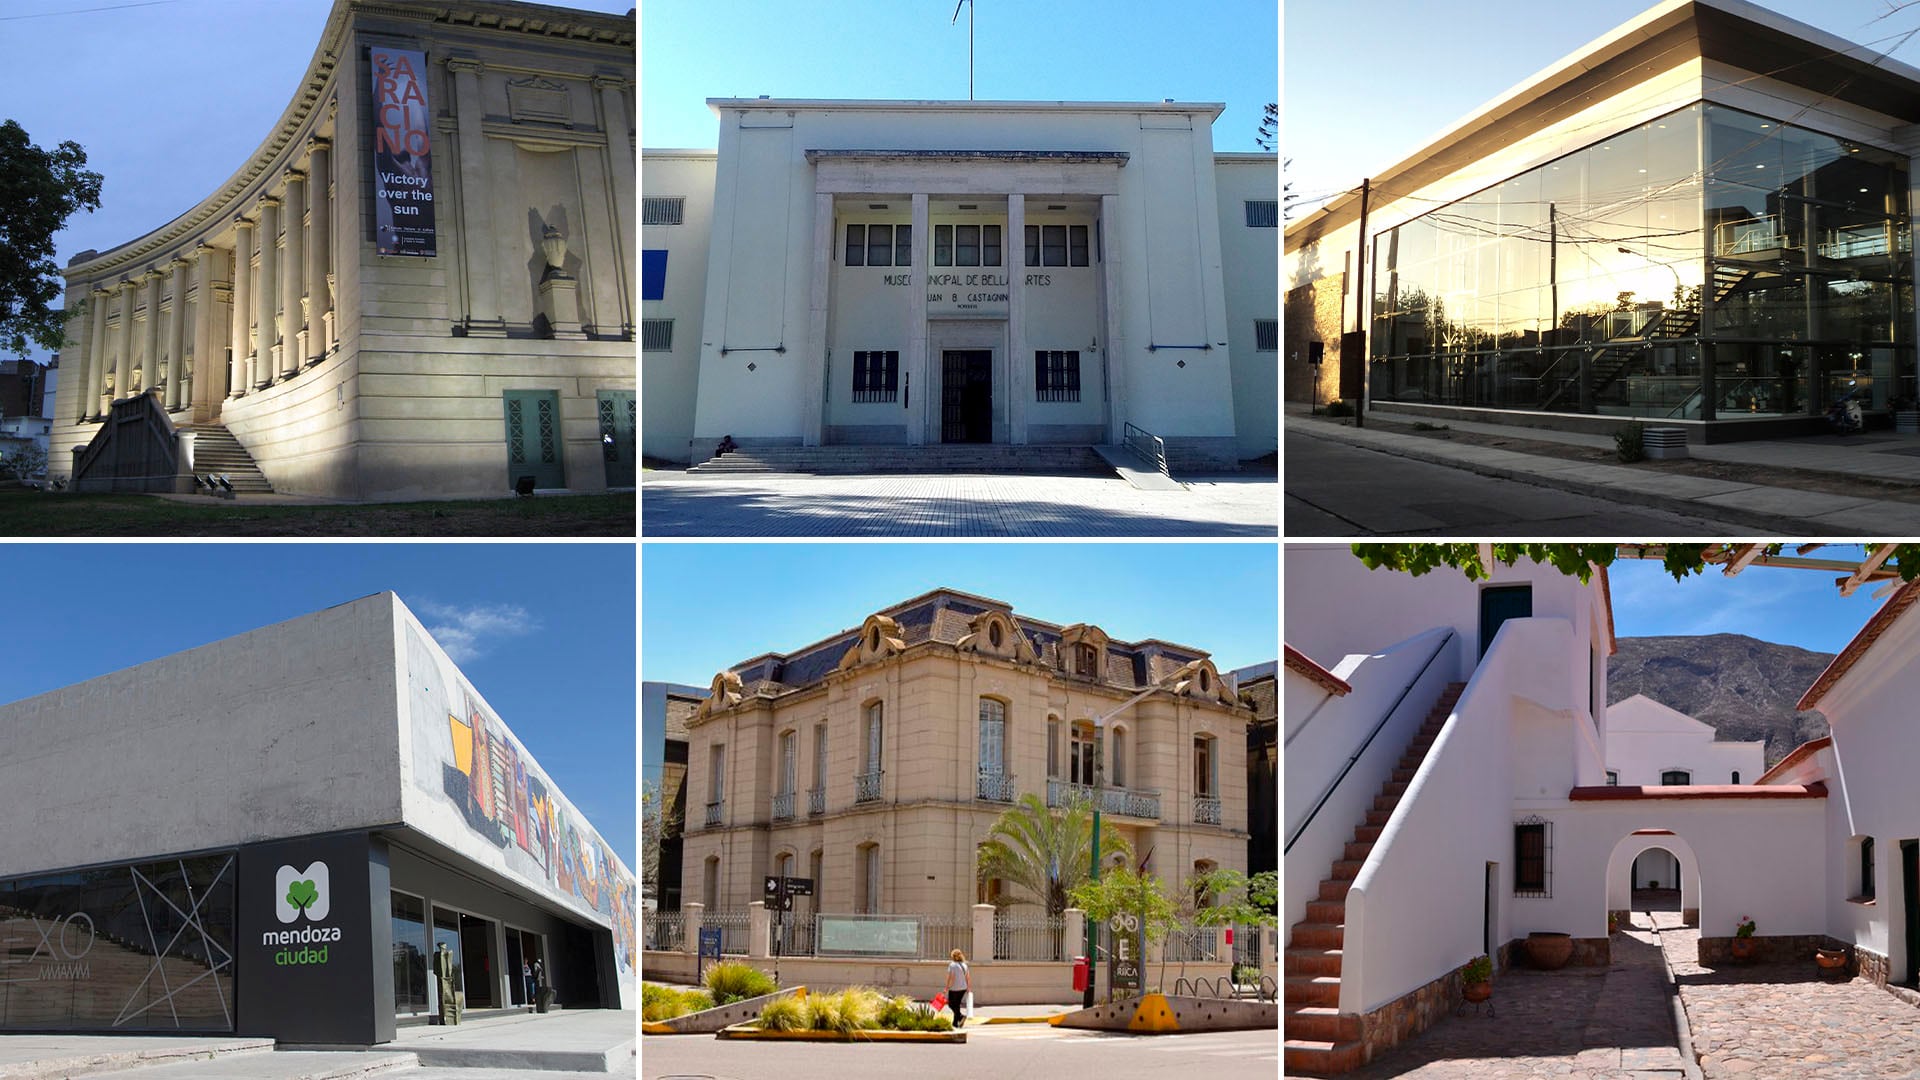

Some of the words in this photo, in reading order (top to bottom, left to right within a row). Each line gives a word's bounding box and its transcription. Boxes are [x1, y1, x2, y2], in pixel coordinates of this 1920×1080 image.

[374, 53, 416, 80] SA
[378, 78, 426, 106] RA
[380, 103, 410, 130] CI
[376, 127, 430, 156] NO
[381, 172, 428, 188] Victory
[378, 189, 408, 199] over
[411, 189, 432, 201] the
[393, 205, 418, 215] sun
[966, 274, 978, 286] DE
[982, 274, 1009, 286] BELL
[927, 293, 942, 302] UAN
[967, 293, 1008, 302] CASTAGNIN
[263, 925, 341, 945] mendoza
[275, 945, 328, 965] ciudad
